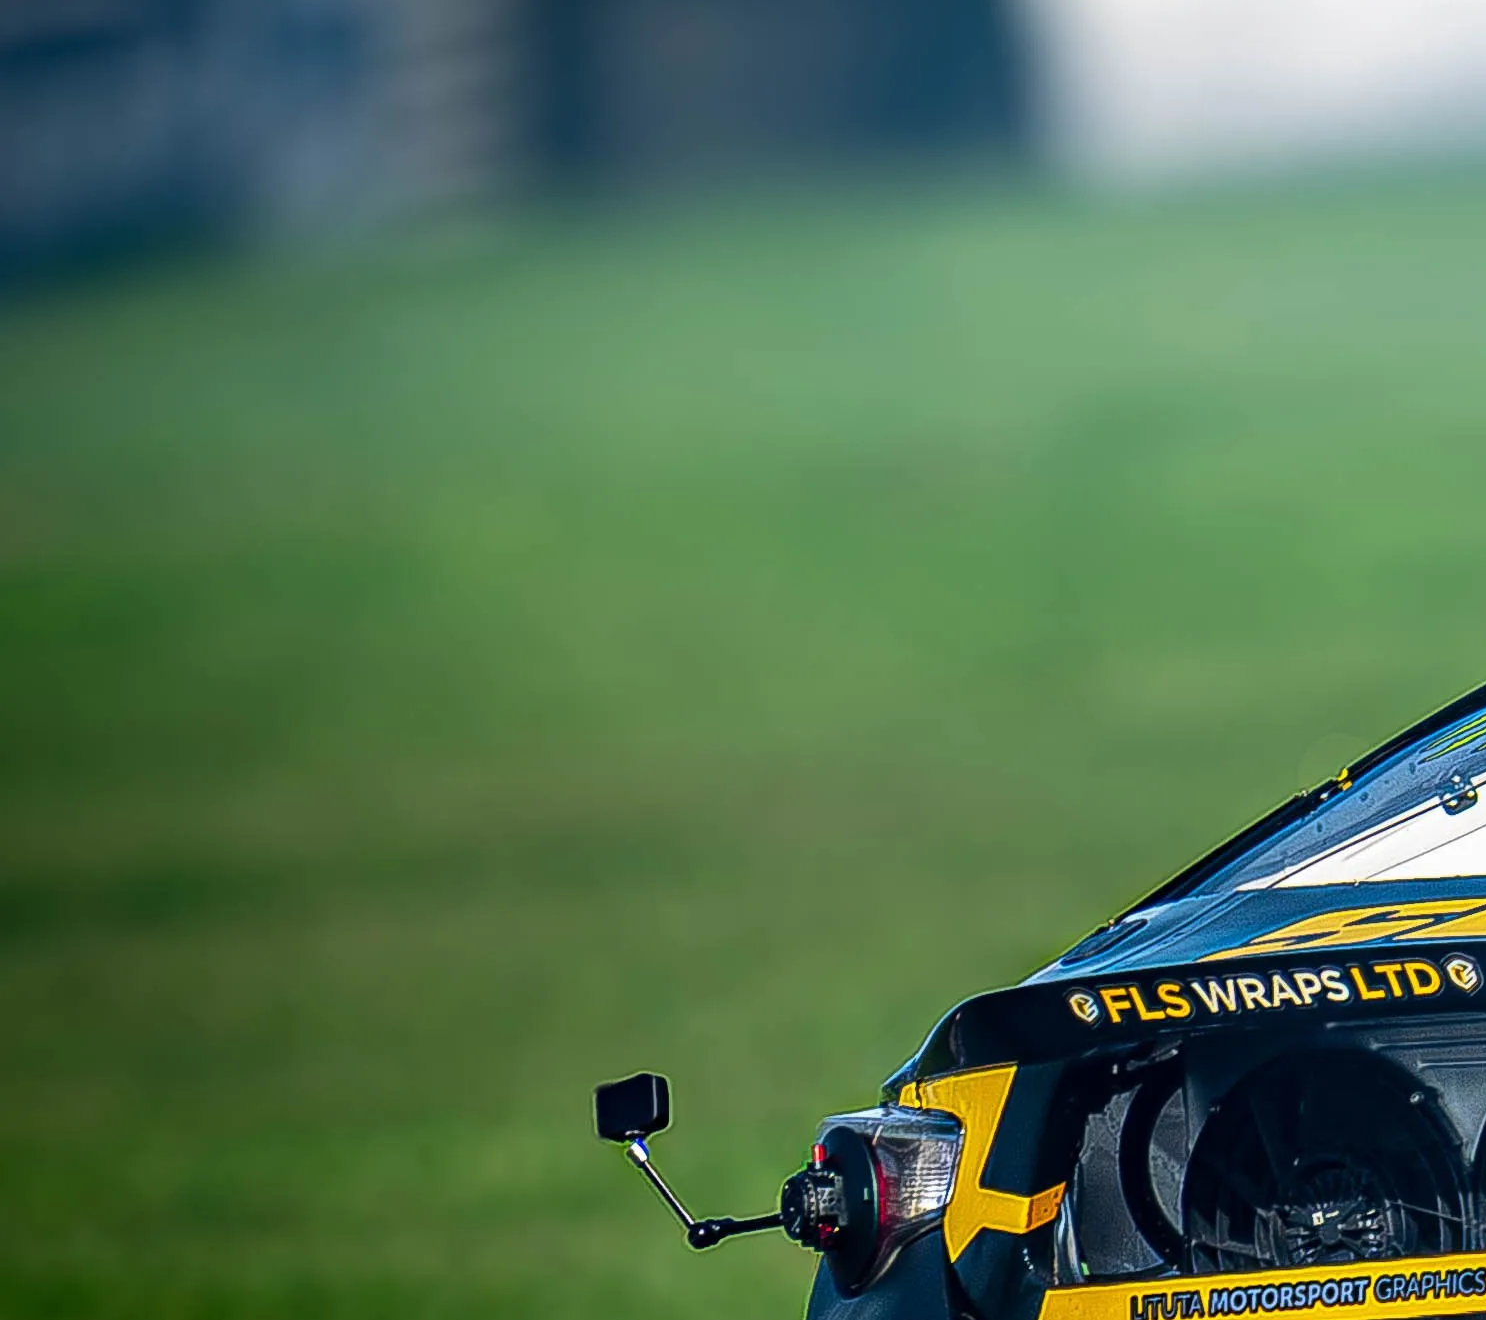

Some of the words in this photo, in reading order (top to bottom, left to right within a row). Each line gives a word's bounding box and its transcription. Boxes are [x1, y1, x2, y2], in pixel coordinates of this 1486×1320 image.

[1101, 981, 1192, 1024] FLS
[1190, 968, 1350, 1014] WRAPS
[1351, 963, 1442, 1003] LTD
[1209, 1279, 1368, 1316] MOTORSPORT
